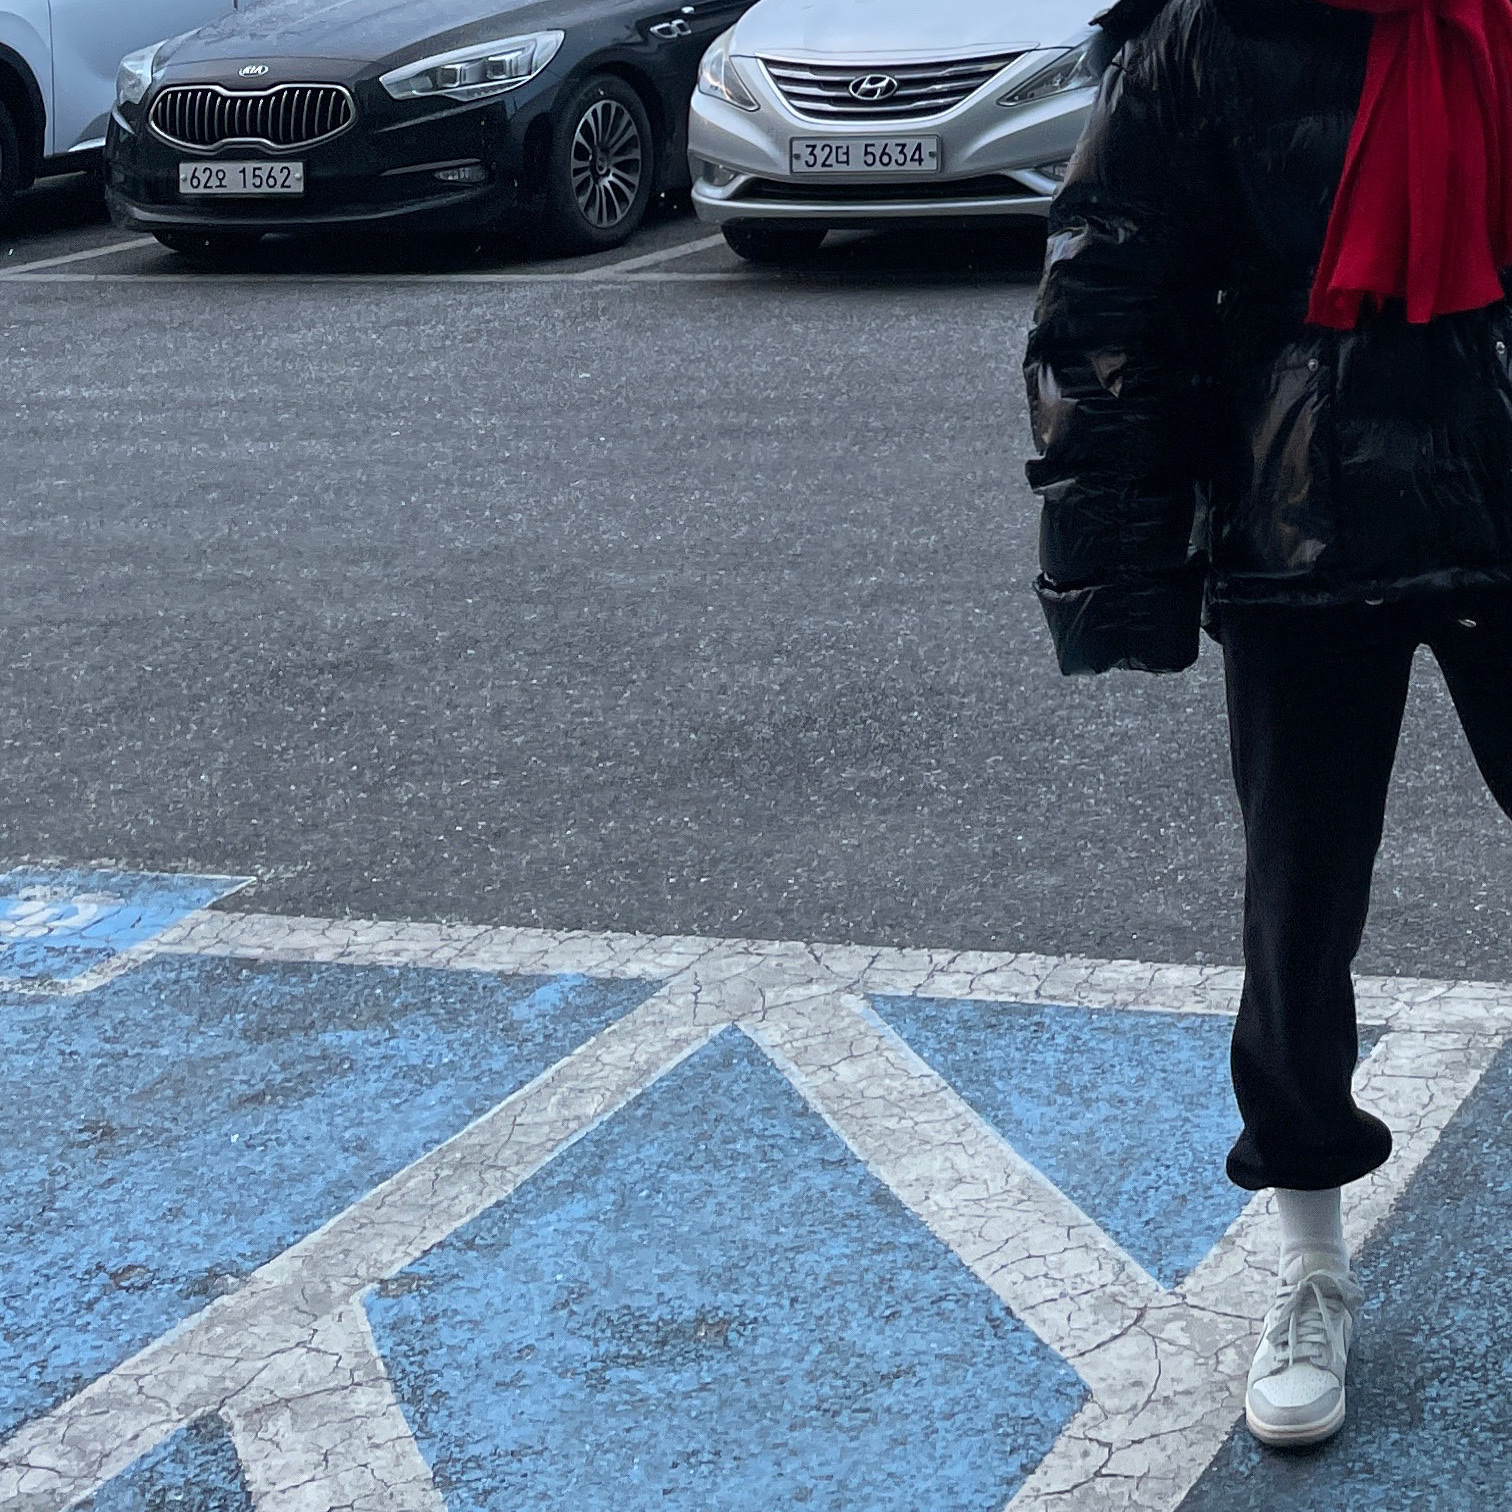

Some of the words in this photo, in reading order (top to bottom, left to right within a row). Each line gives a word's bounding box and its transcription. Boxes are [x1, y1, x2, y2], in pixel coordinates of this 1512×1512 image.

[803, 143, 850, 168] 32더
[863, 142, 925, 167] 5634
[189, 167, 228, 189] 62오
[238, 166, 292, 189] 1562
